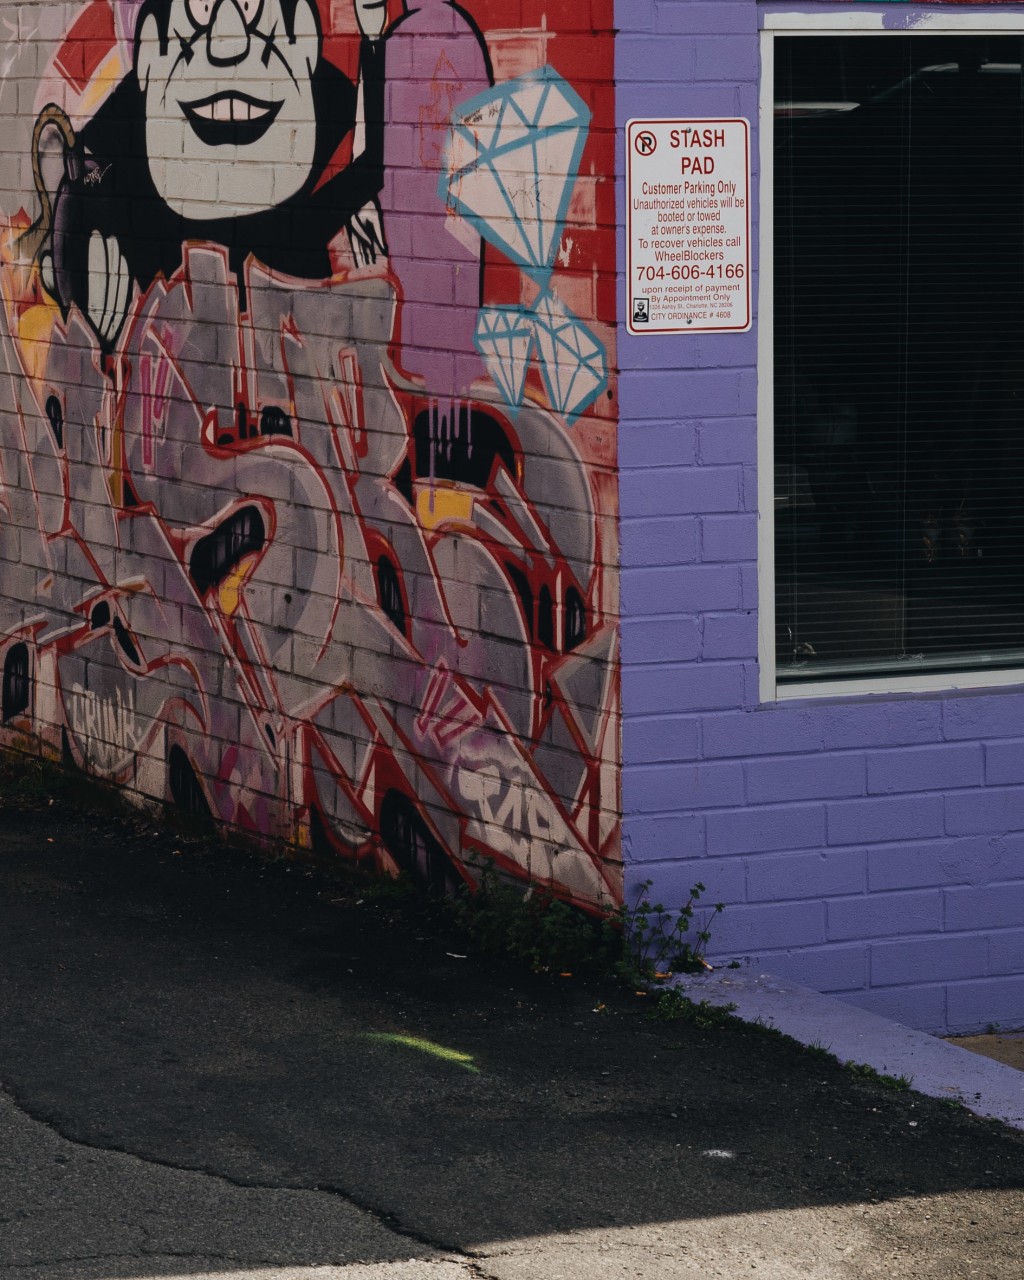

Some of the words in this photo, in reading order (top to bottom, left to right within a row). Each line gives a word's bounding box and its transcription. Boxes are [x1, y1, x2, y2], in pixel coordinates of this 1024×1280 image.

[669, 128, 726, 149] STASH
[680, 156, 716, 175] PAD
[641, 181, 682, 196] Customer
[684, 180, 716, 197] Parking
[717, 179, 737, 197] Only
[633, 197, 685, 210] Unauthorized
[686, 197, 719, 209] vehicles
[720, 196, 733, 208] will
[734, 197, 745, 208] be
[657, 210, 685, 223] booted
[687, 212, 696, 222] or
[696, 209, 721, 221] towed
[651, 224, 659, 236] at
[660, 223, 691, 235] owner's
[692, 223, 727, 237] expense.
[638, 238, 649, 249] To
[650, 239, 685, 249] recover
[686, 236, 723, 248] vehicles
[725, 235, 741, 247] call
[654, 249, 724, 262] WheelBlockers
[636, 263, 745, 281] 704-606-4166
[641, 285, 663, 294] upon
[664, 284, 693, 294] receipt
[694, 283, 703, 292] of
[705, 283, 740, 293] payment
[650, 295, 661, 303] By
[663, 294, 711, 303] Appointment
[712, 293, 731, 302] Only
[650, 312, 666, 321] CITY
[667, 311, 707, 320] ORDINANCE
